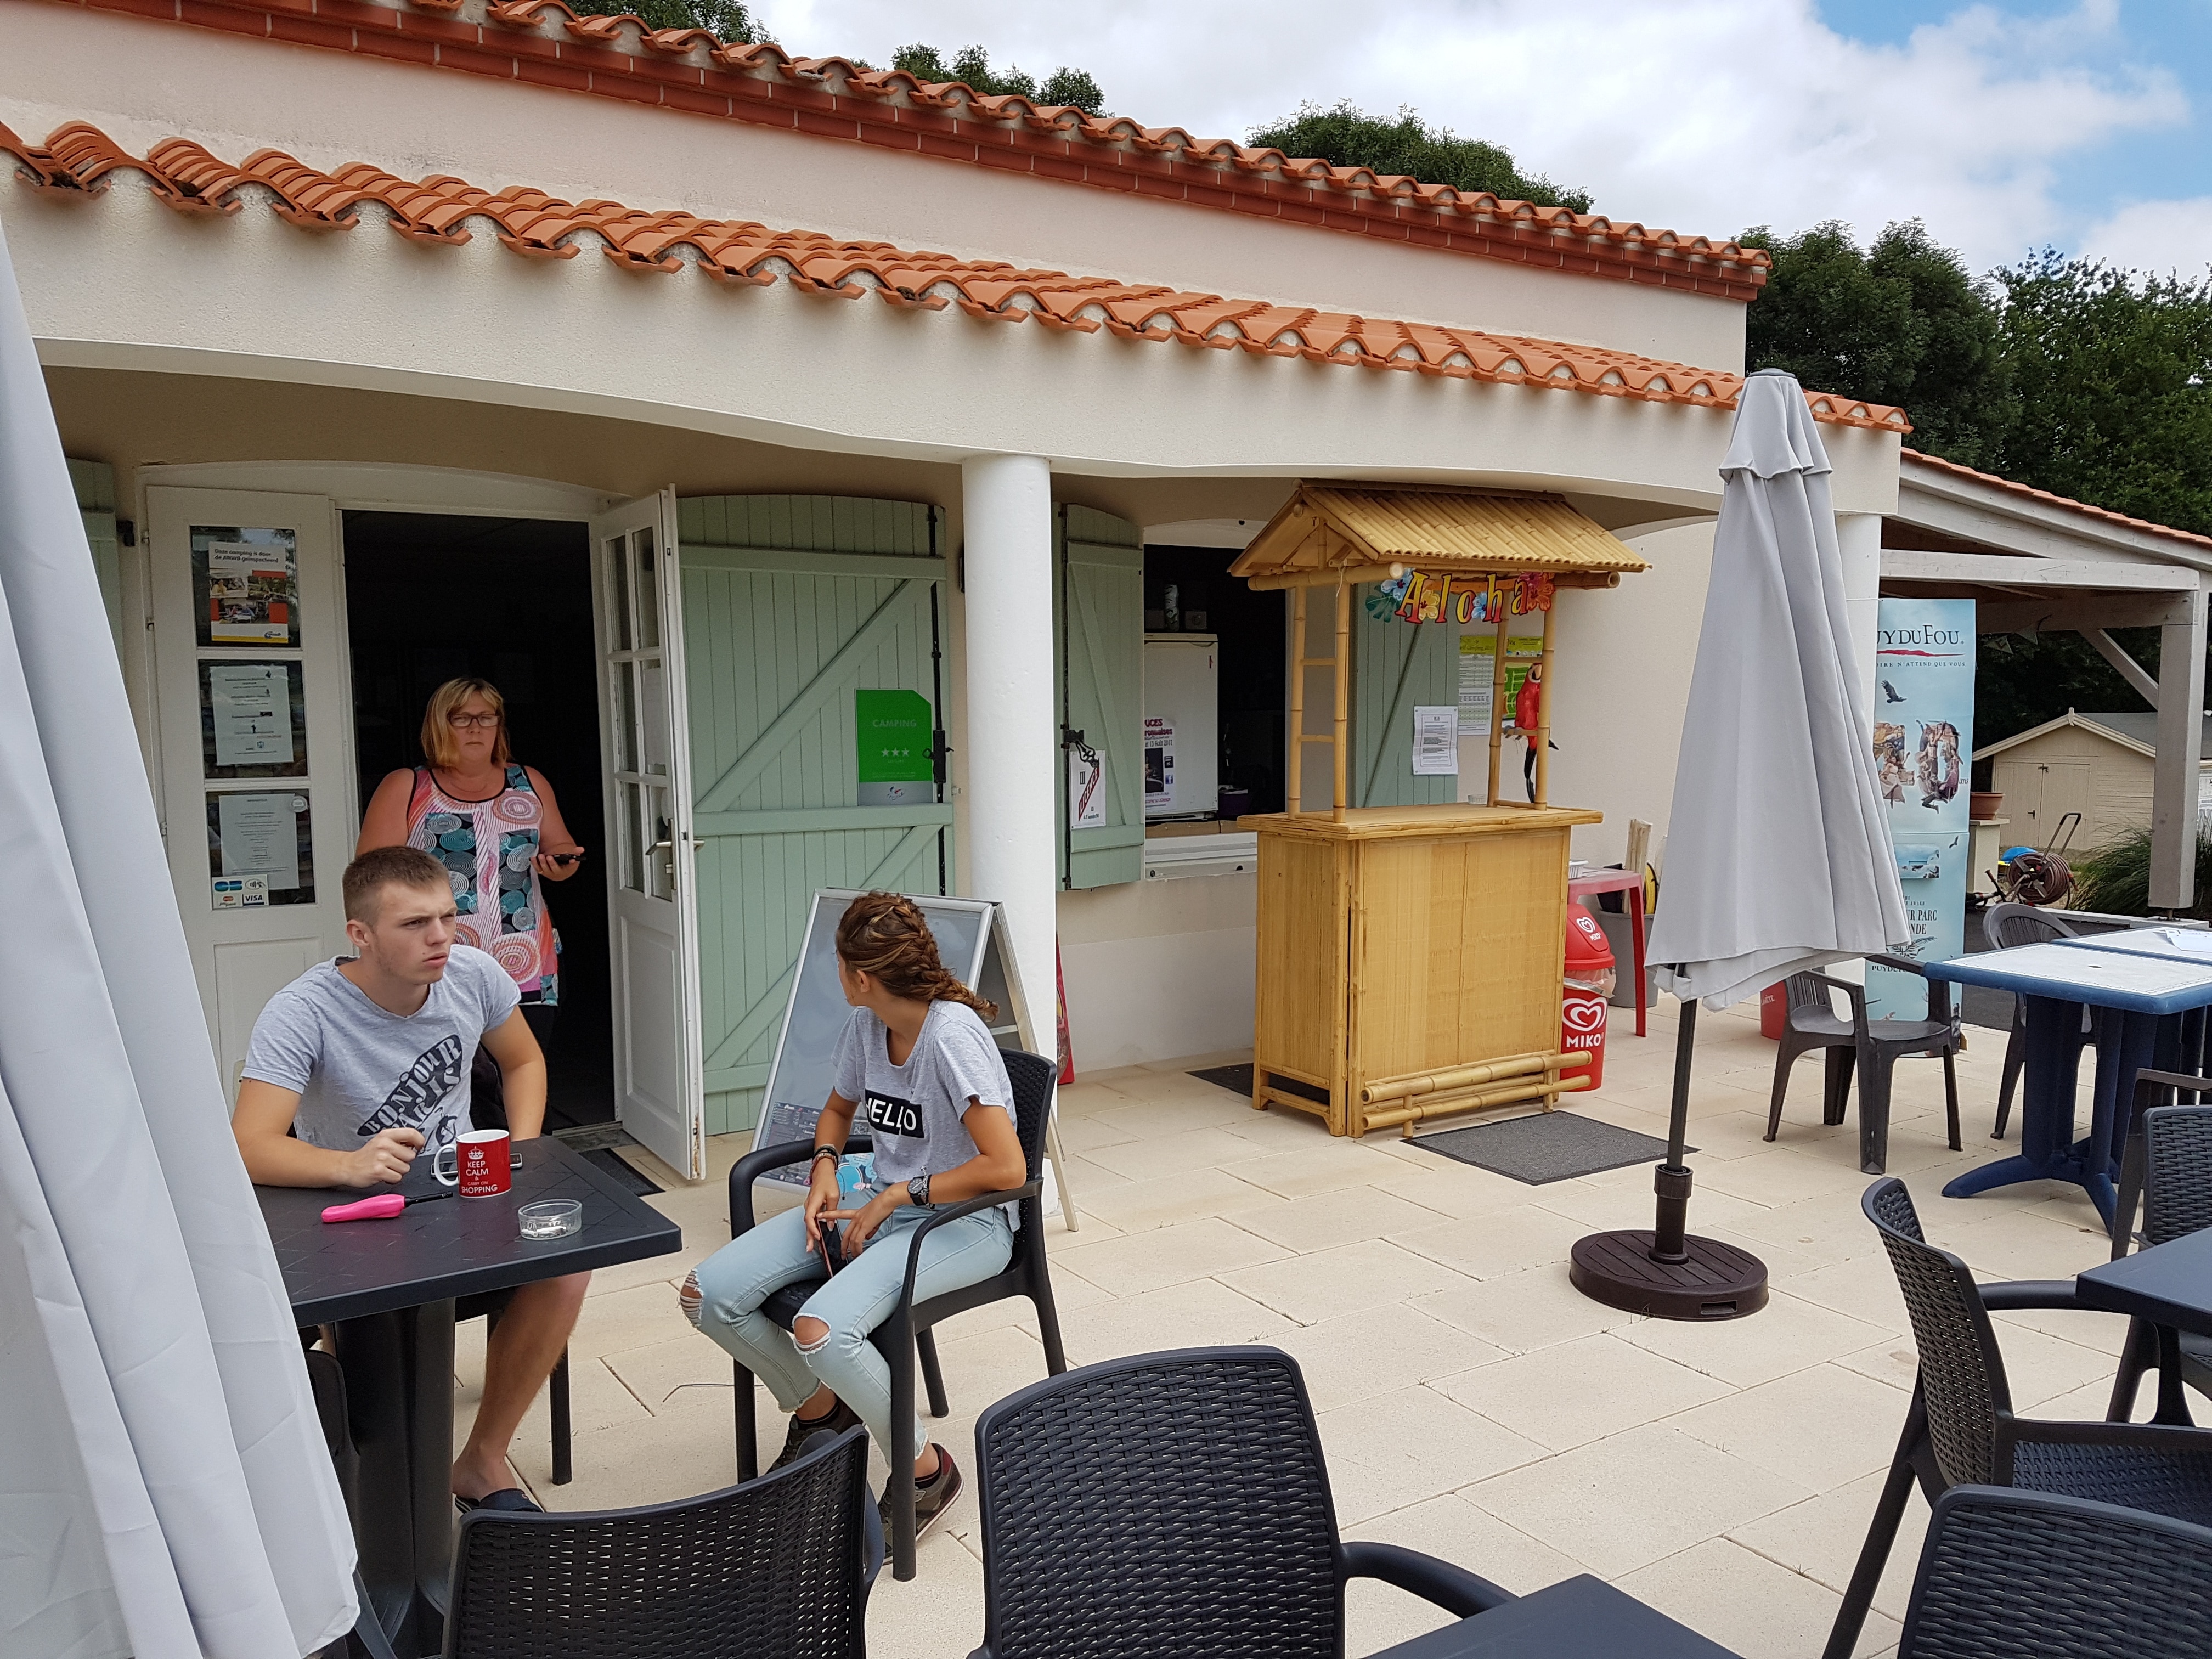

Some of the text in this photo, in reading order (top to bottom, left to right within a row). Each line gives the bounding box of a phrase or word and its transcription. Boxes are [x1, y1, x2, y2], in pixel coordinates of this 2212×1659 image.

[1394, 570, 1529, 624] Aloha
[873, 719, 917, 727] CAMPING
[1918, 910, 1937, 921] PARC
[1909, 923, 1926, 934] NDE
[1567, 1035, 1601, 1047] MIKO
[364, 1037, 461, 1133] BONJOUR
[391, 1066, 460, 1129] ARIS
[467, 1160, 486, 1169] KEEP
[466, 1168, 488, 1176] CALM
[461, 1184, 498, 1194] SHOPPING
